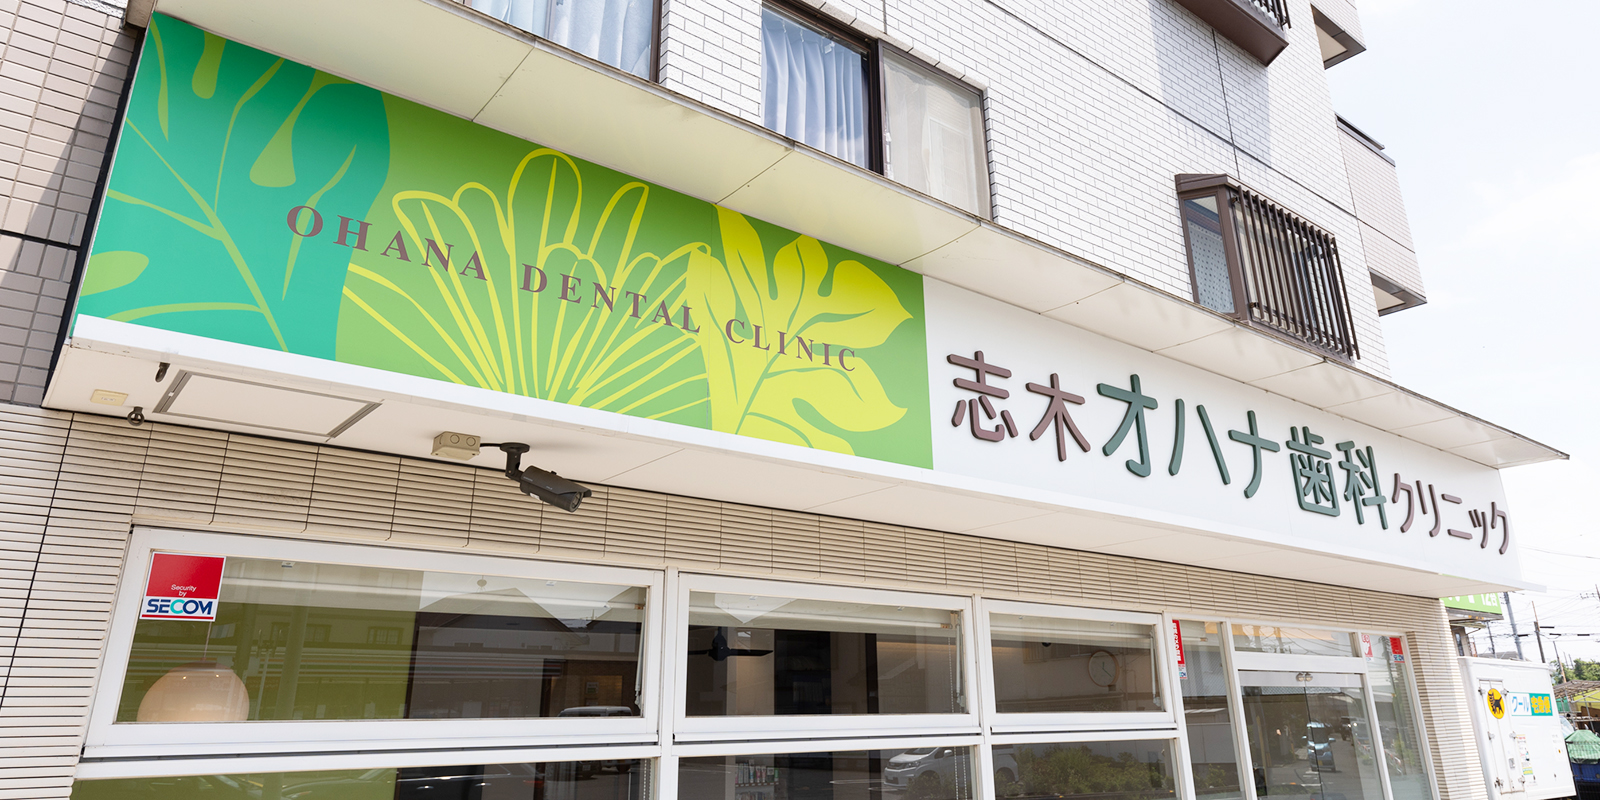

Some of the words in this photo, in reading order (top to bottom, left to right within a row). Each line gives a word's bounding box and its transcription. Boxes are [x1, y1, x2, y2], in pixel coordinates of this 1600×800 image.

[286, 205, 488, 282] OHANA
[520, 263, 702, 334] DENTAL
[725, 318, 857, 373] CLINIC
[170, 584, 197, 592] Security
[178, 590, 187, 598] by
[146, 598, 213, 615] SECOM
